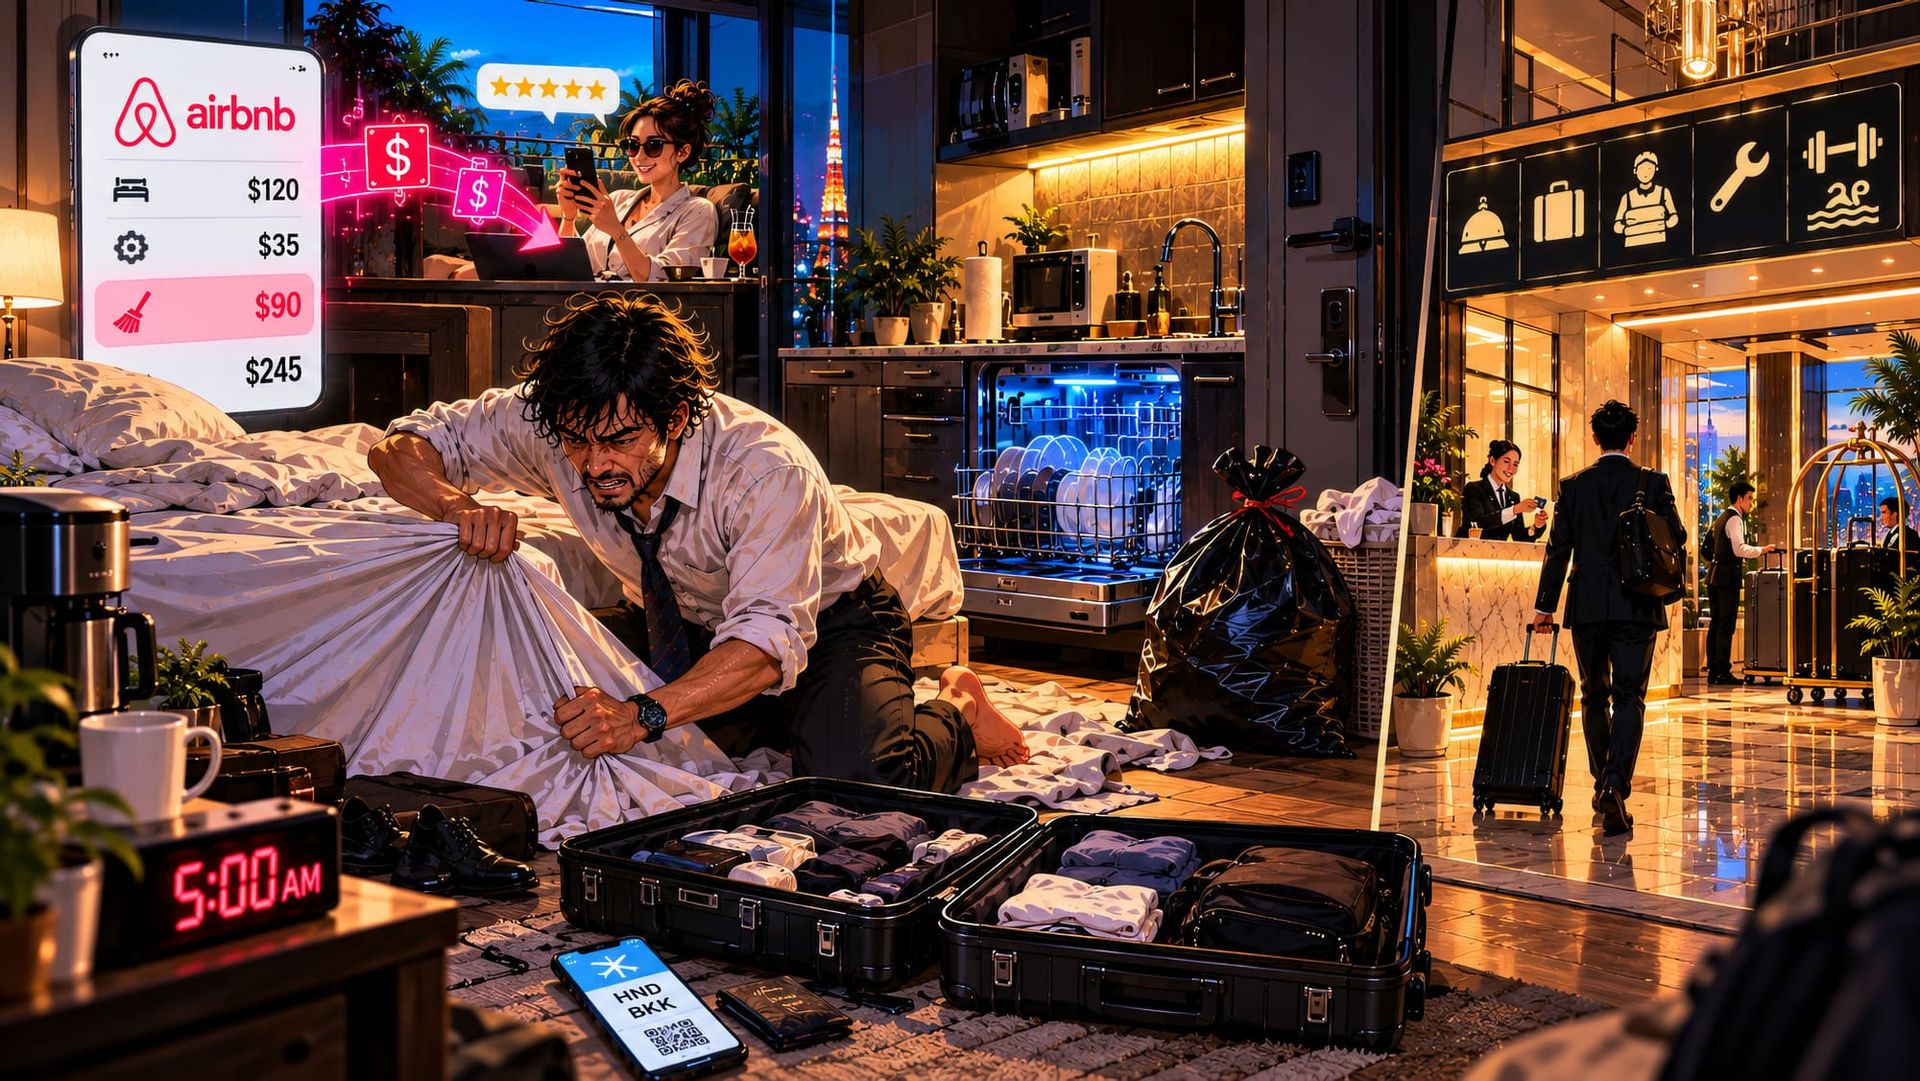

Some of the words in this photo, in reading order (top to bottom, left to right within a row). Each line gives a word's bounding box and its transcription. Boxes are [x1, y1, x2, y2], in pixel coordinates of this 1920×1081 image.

[186, 94, 296, 132] airbnb
[385, 132, 411, 181] $
[248, 176, 299, 203] $120
[469, 175, 488, 212] $
[258, 232, 299, 259] $35
[255, 290, 301, 321] $90
[245, 355, 302, 387] $245
[174, 847, 278, 931] 5:00
[281, 863, 321, 902] AM
[613, 983, 662, 1005] HND
[627, 997, 677, 1019] BKK
